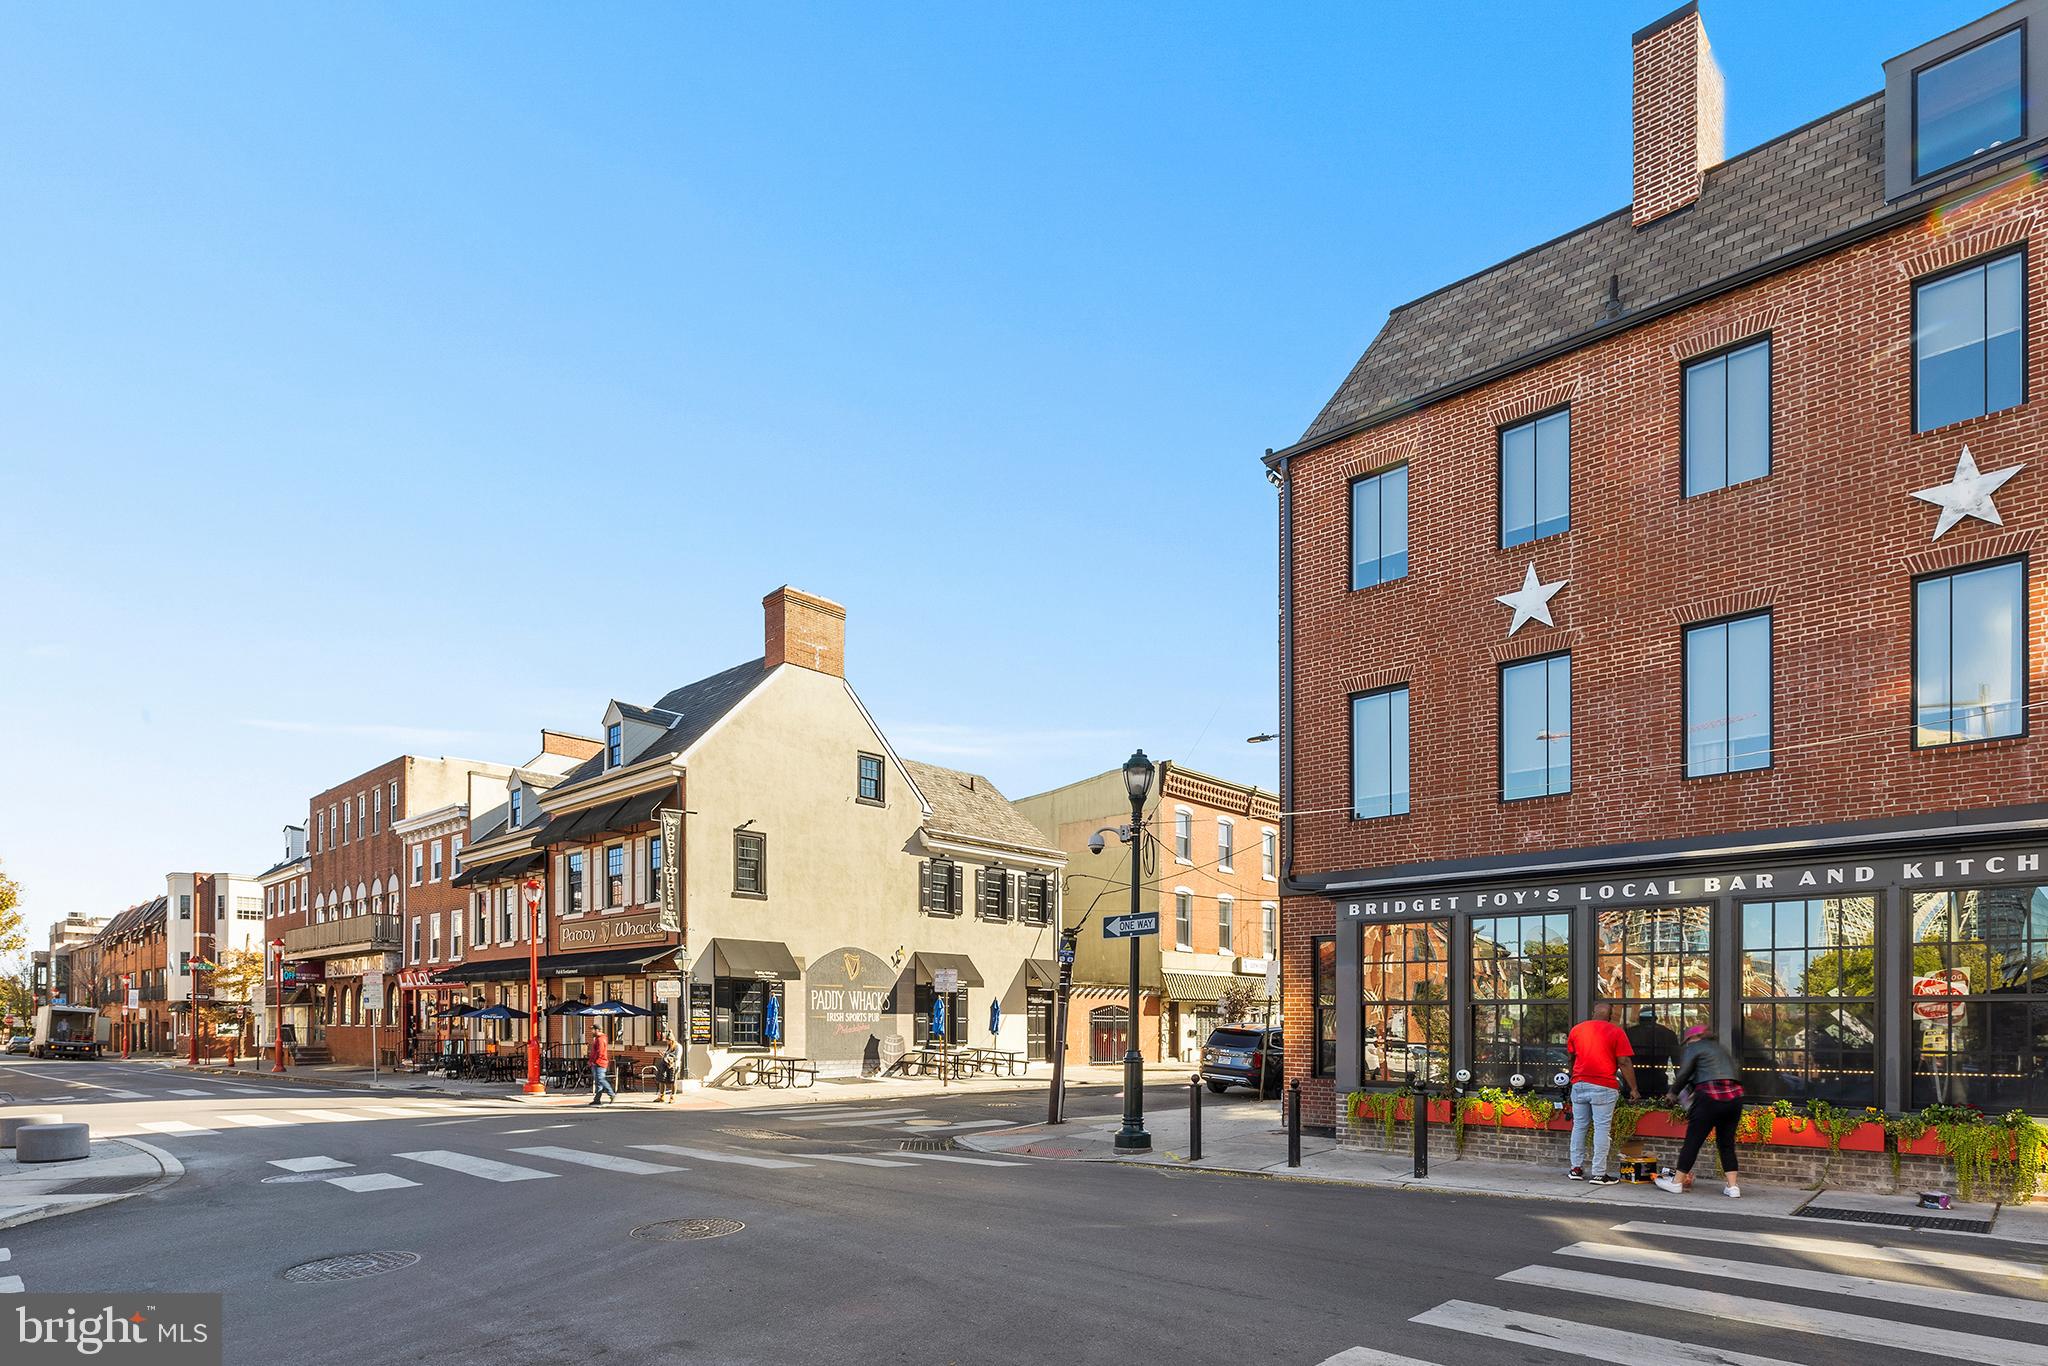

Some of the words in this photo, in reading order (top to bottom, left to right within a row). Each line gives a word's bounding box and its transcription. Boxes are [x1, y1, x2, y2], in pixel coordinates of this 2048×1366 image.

[1349, 896, 1459, 916] BRIDGET
[1477, 889, 1560, 908] FOY'S
[1580, 880, 1682, 901] LOCAL
[1704, 873, 1774, 893] BAR
[1798, 866, 1875, 886] AND
[1903, 854, 2039, 880] KITCH
[615, 920, 662, 937] Whacks
[1120, 921, 1135, 931] ONE
[1137, 919, 1153, 929] WAY
[811, 990, 845, 1010] PADDY
[848, 991, 891, 1011] WHACKS
[826, 1012, 844, 1022] IRISH
[845, 1013, 867, 1023] SPORTS
[867, 1014, 880, 1023] PUB
